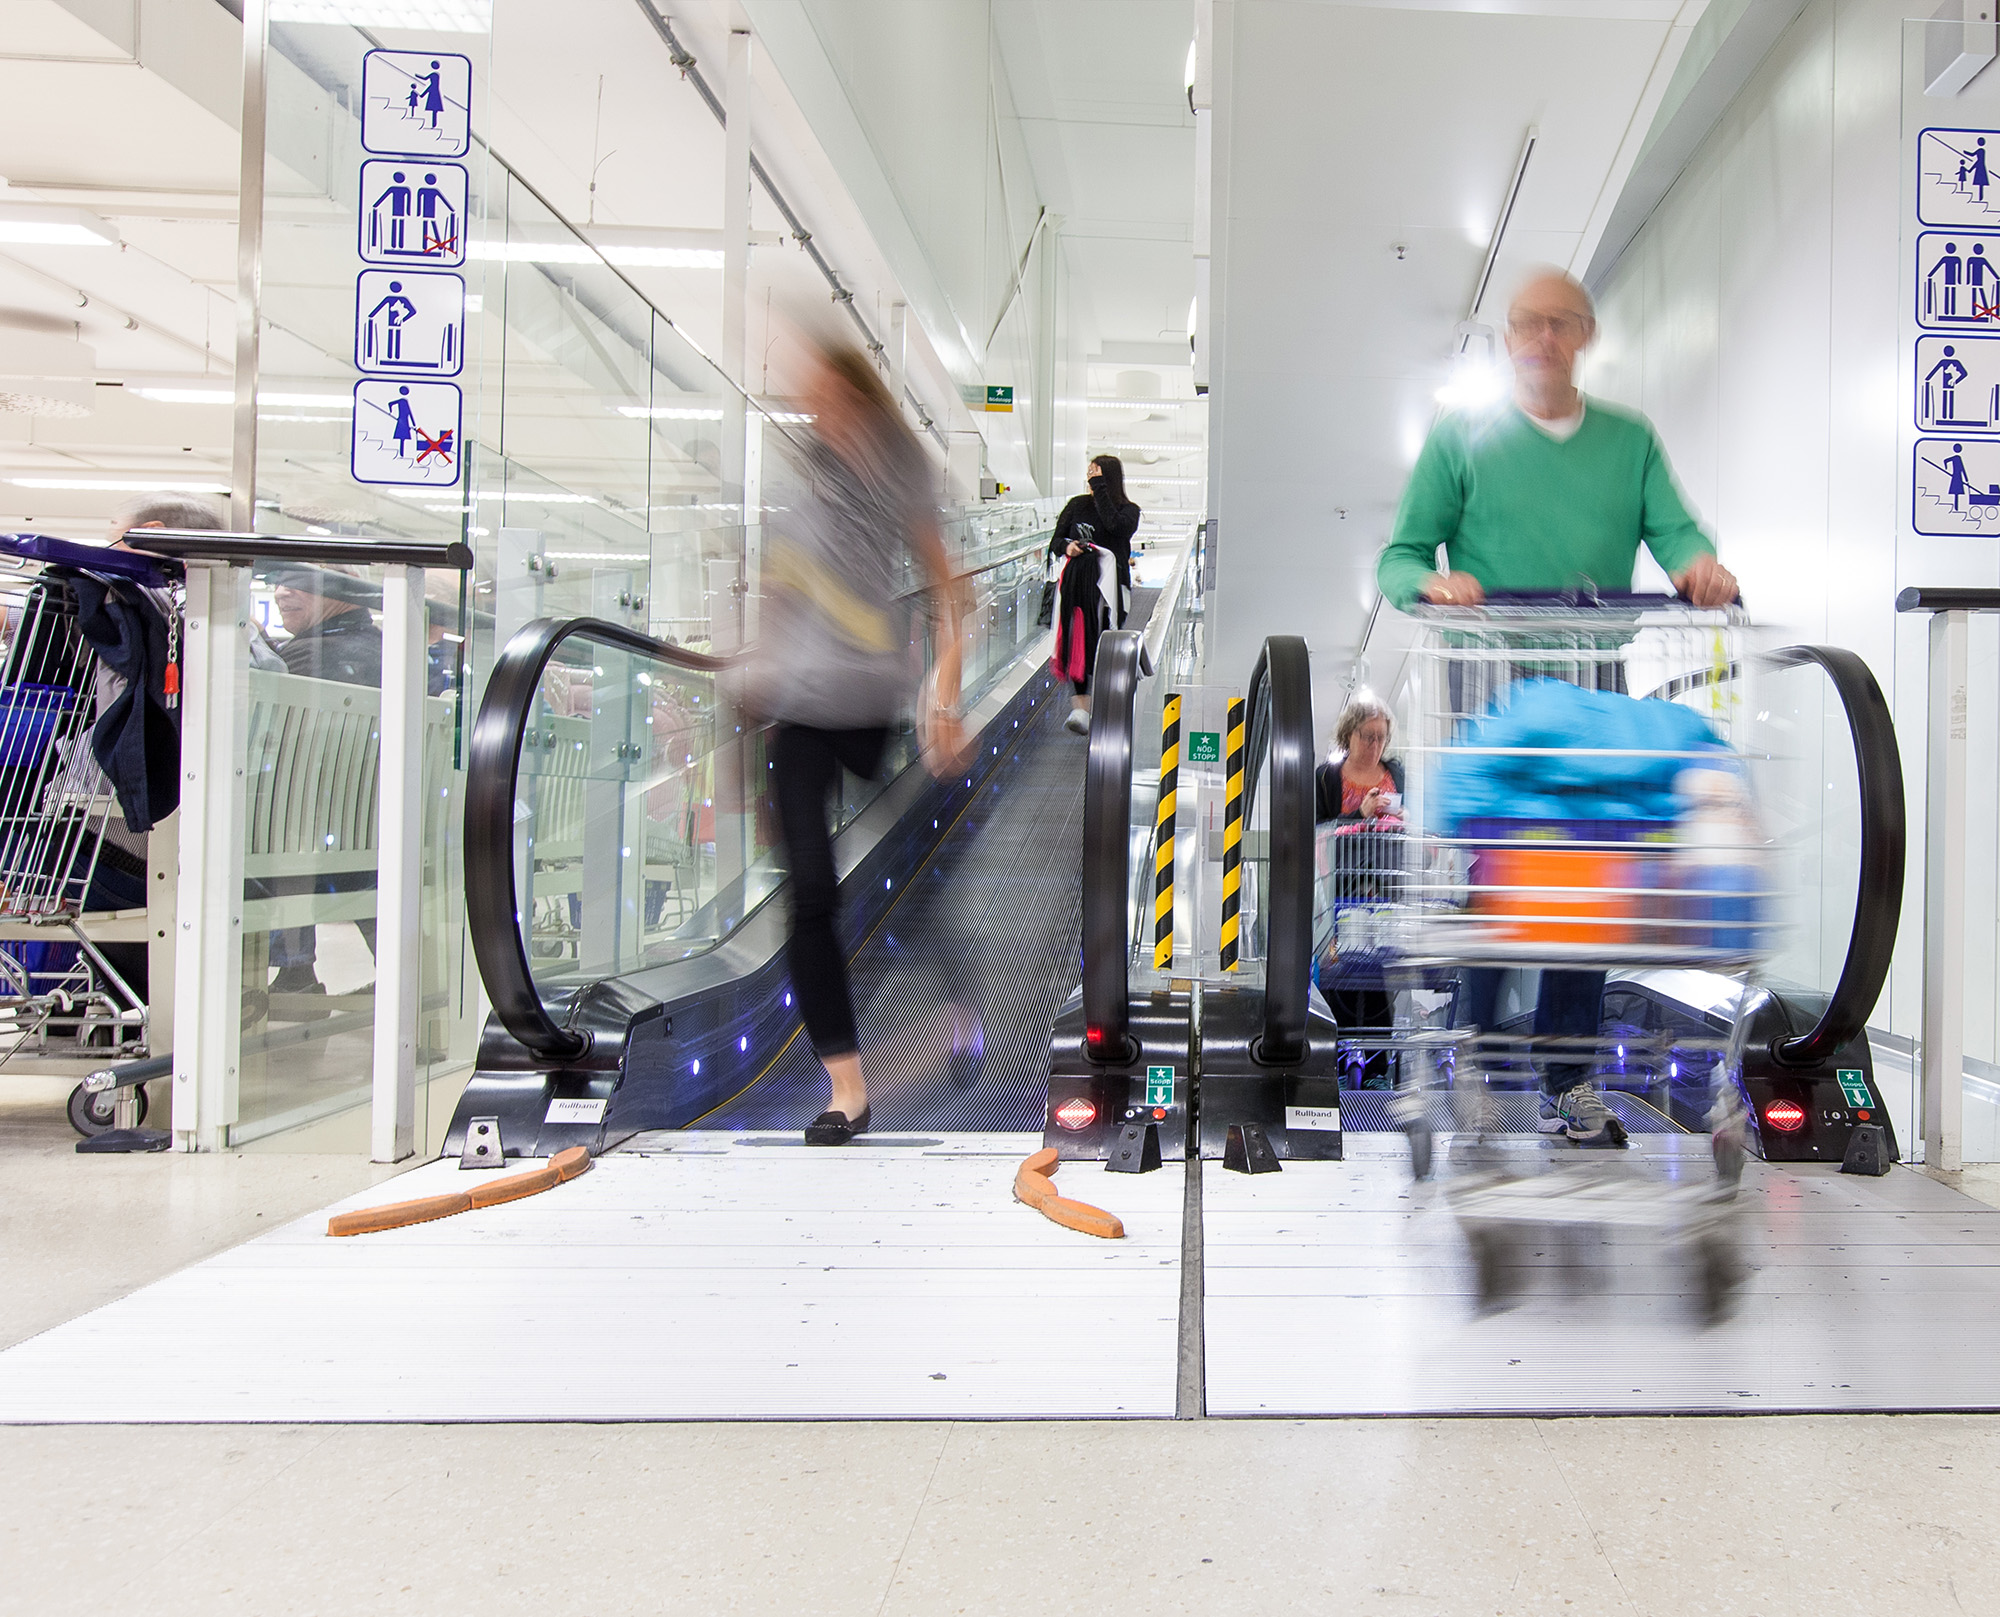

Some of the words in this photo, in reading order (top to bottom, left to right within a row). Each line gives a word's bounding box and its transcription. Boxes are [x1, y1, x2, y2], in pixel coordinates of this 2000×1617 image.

[1196, 744, 1216, 753] NÖD-
[1192, 752, 1216, 760] STOPP
[1150, 1078, 1172, 1086] Stopp
[573, 1111, 579, 1119] 7
[1295, 1109, 1332, 1118] Rullband
[1311, 1119, 1317, 1127] 6
